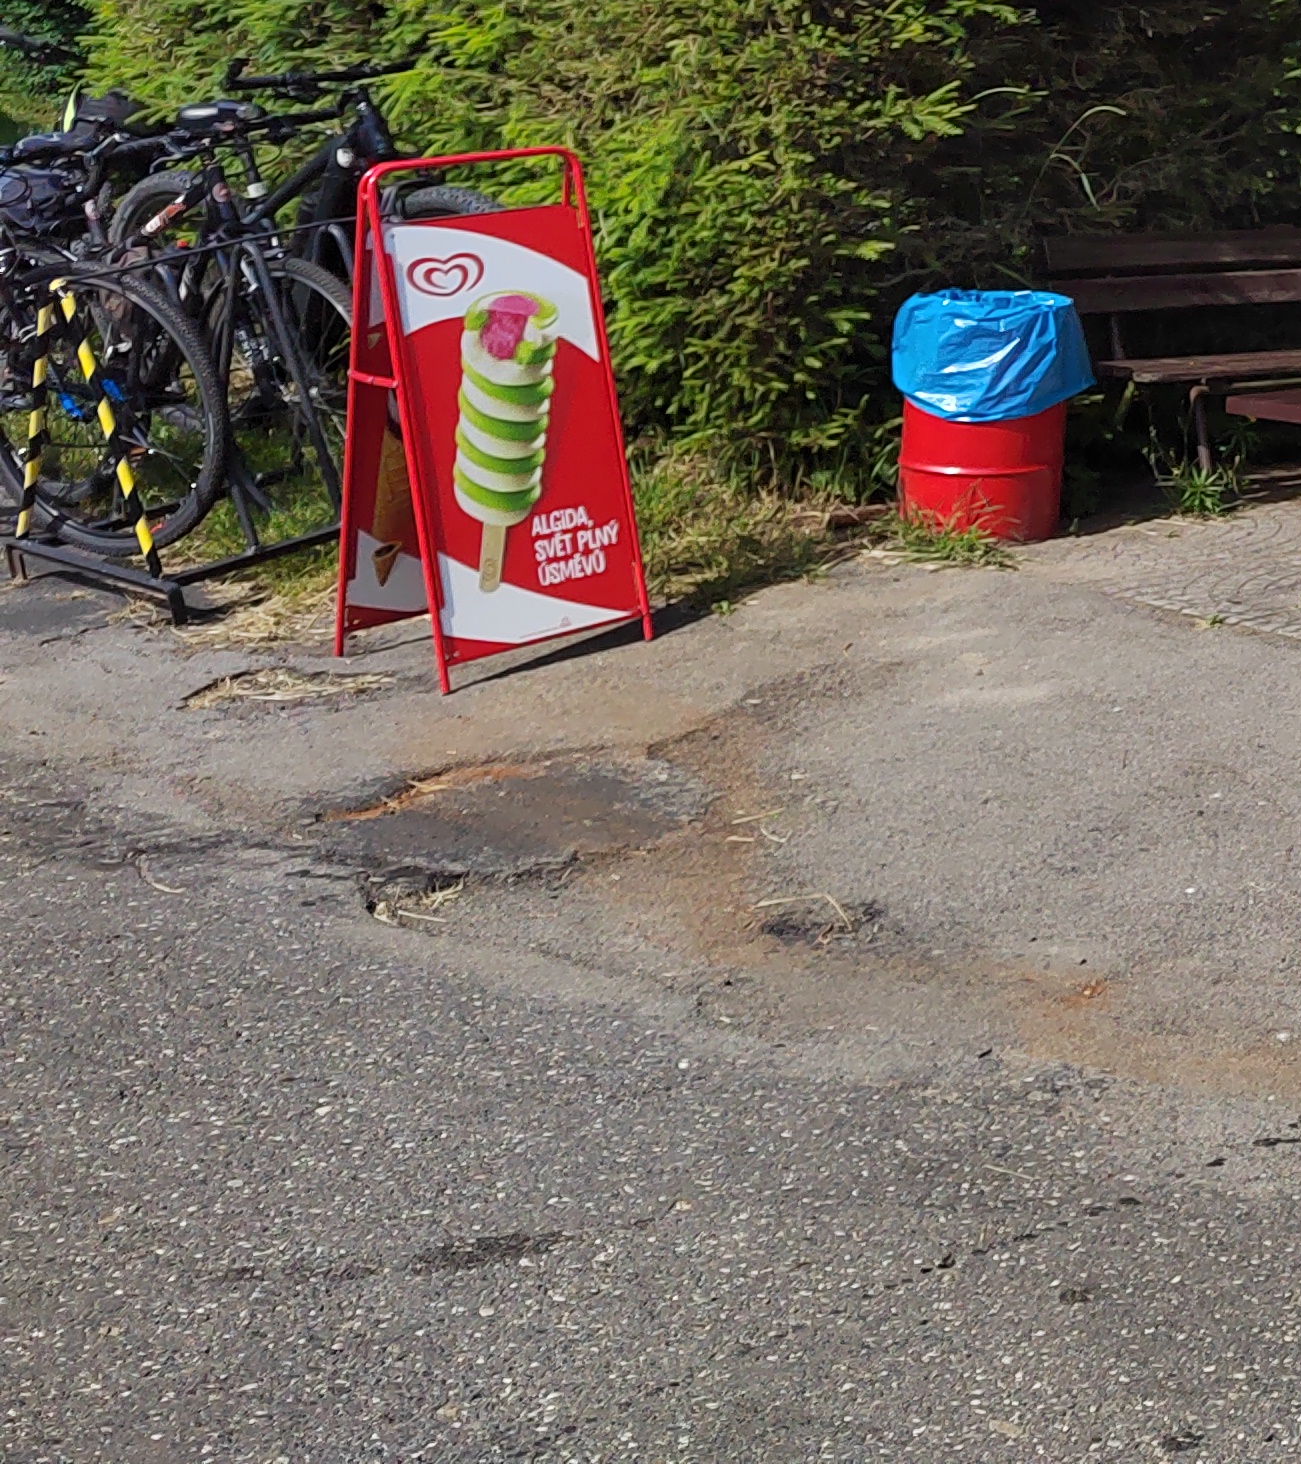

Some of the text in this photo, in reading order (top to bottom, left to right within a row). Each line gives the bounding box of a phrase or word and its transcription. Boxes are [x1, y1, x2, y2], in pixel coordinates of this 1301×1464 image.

[534, 518, 619, 562] SVĚT PLNÝ
[538, 548, 607, 587] ÚSMĚVŮ
